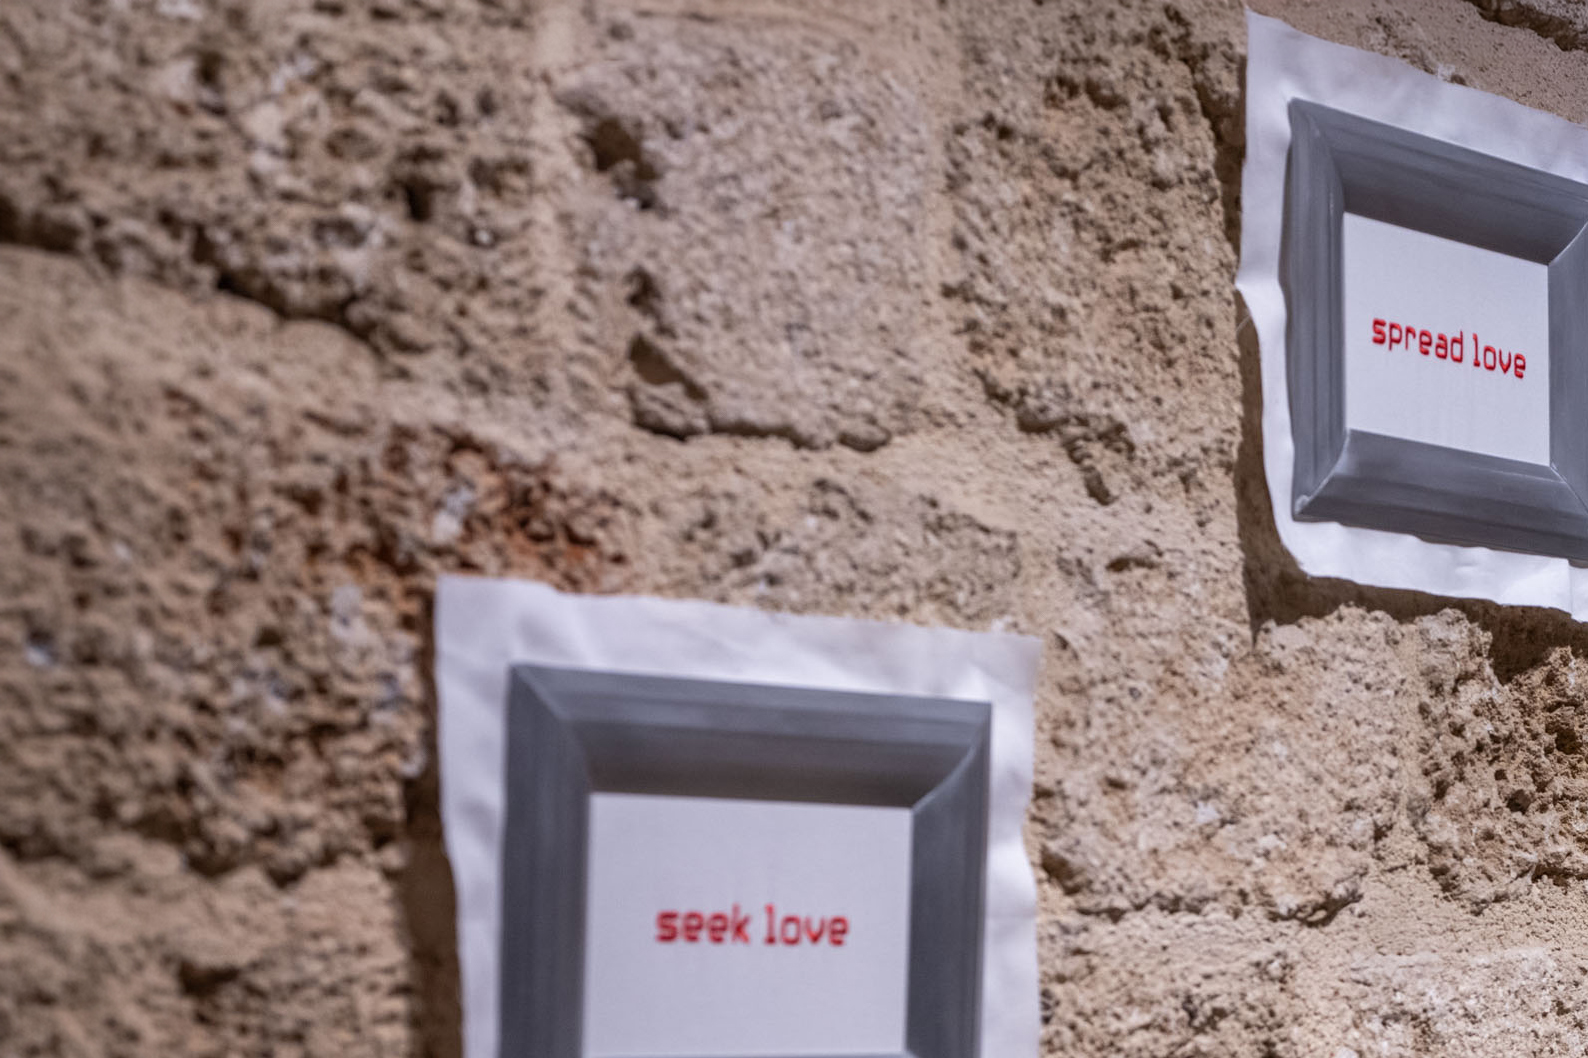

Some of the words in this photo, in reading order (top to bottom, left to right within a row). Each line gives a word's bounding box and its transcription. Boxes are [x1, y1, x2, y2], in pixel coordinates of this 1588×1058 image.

[1371, 317, 1464, 364] spread
[1472, 332, 1527, 380] love
[655, 904, 751, 944] seek
[764, 903, 849, 946] love
